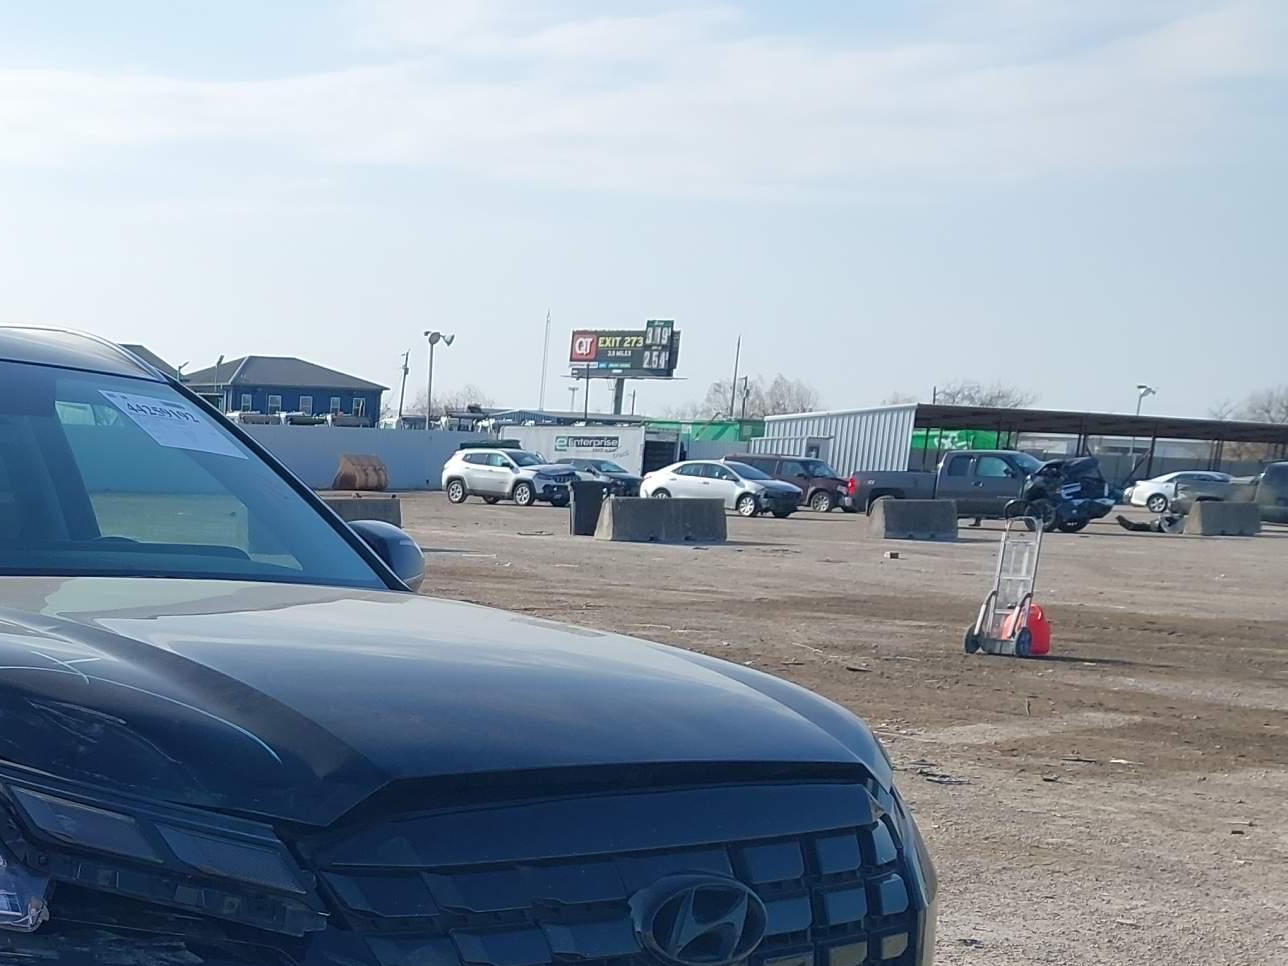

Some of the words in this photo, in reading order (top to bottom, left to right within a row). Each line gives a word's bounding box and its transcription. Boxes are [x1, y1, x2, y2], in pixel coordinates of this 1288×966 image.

[575, 337, 593, 355] QT
[598, 337, 622, 348] EXIT
[623, 336, 643, 347] 273
[127, 402, 200, 424] 44259192
